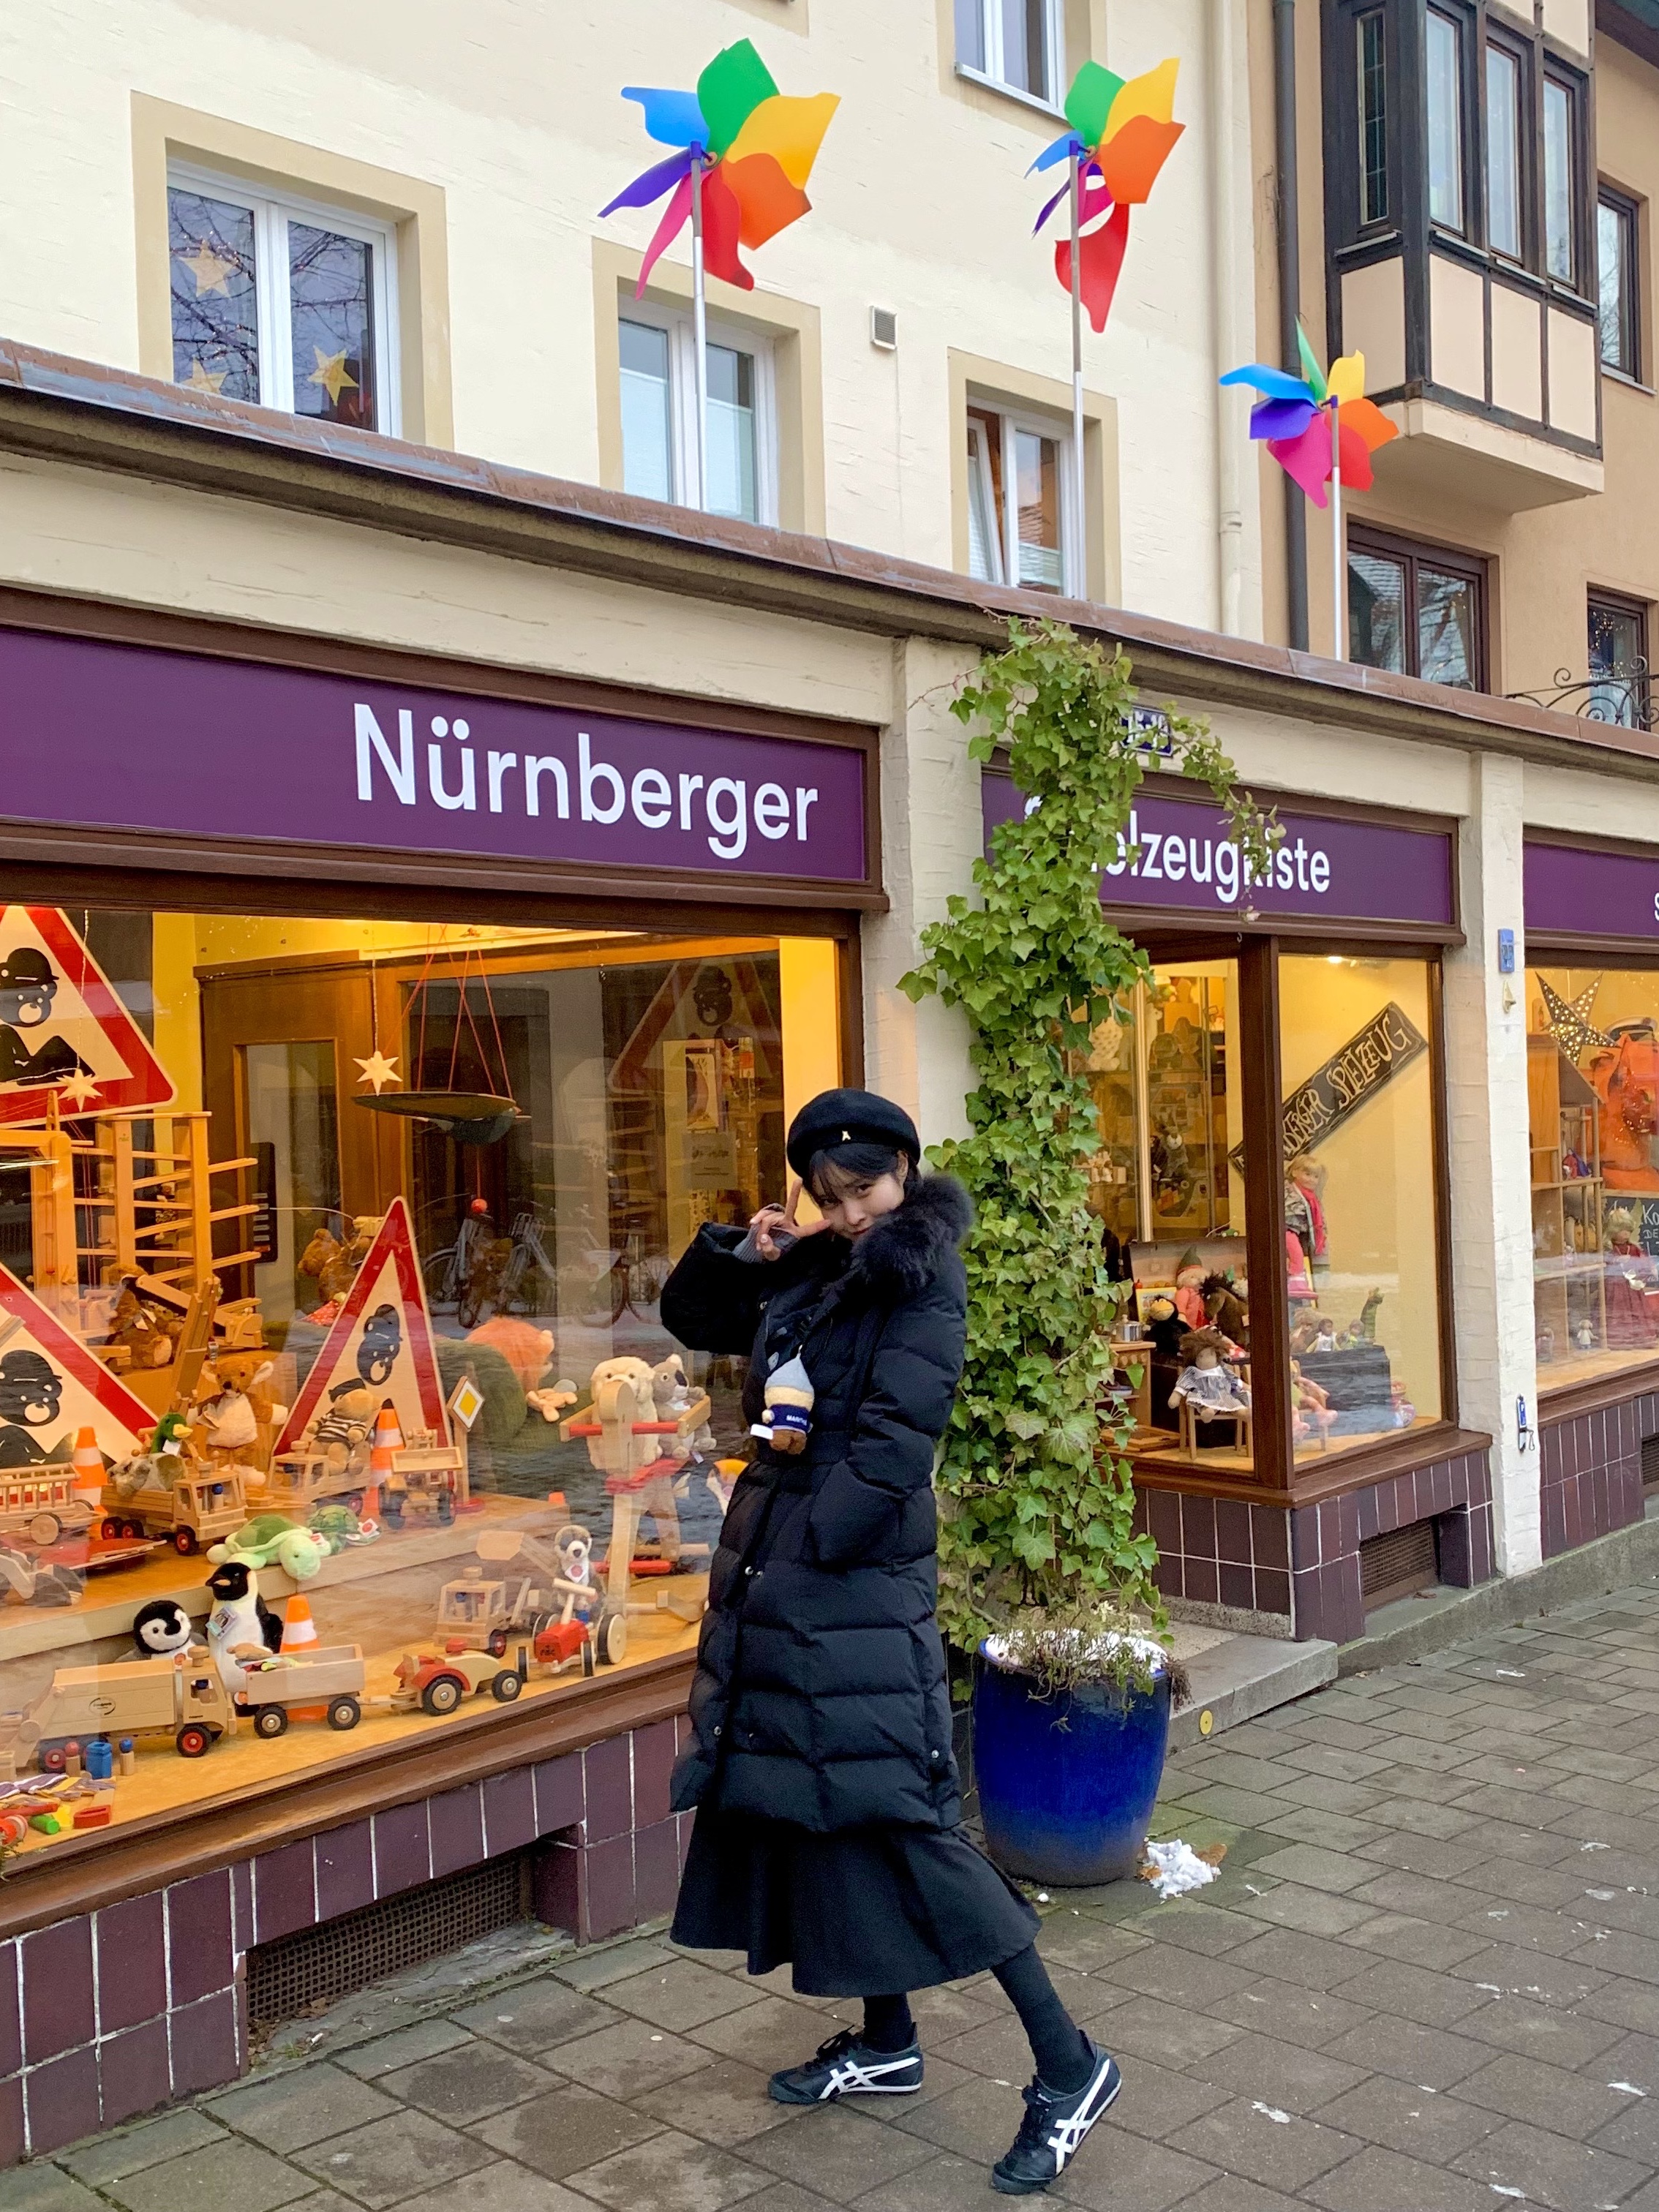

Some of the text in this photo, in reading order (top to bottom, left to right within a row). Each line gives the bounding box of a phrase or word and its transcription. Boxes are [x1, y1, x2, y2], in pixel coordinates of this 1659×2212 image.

[354, 703, 819, 859] Nürnberger
[1024, 795, 1331, 903] elzeugkiste
[1325, 1014, 1412, 1110] SPIELZEUG
